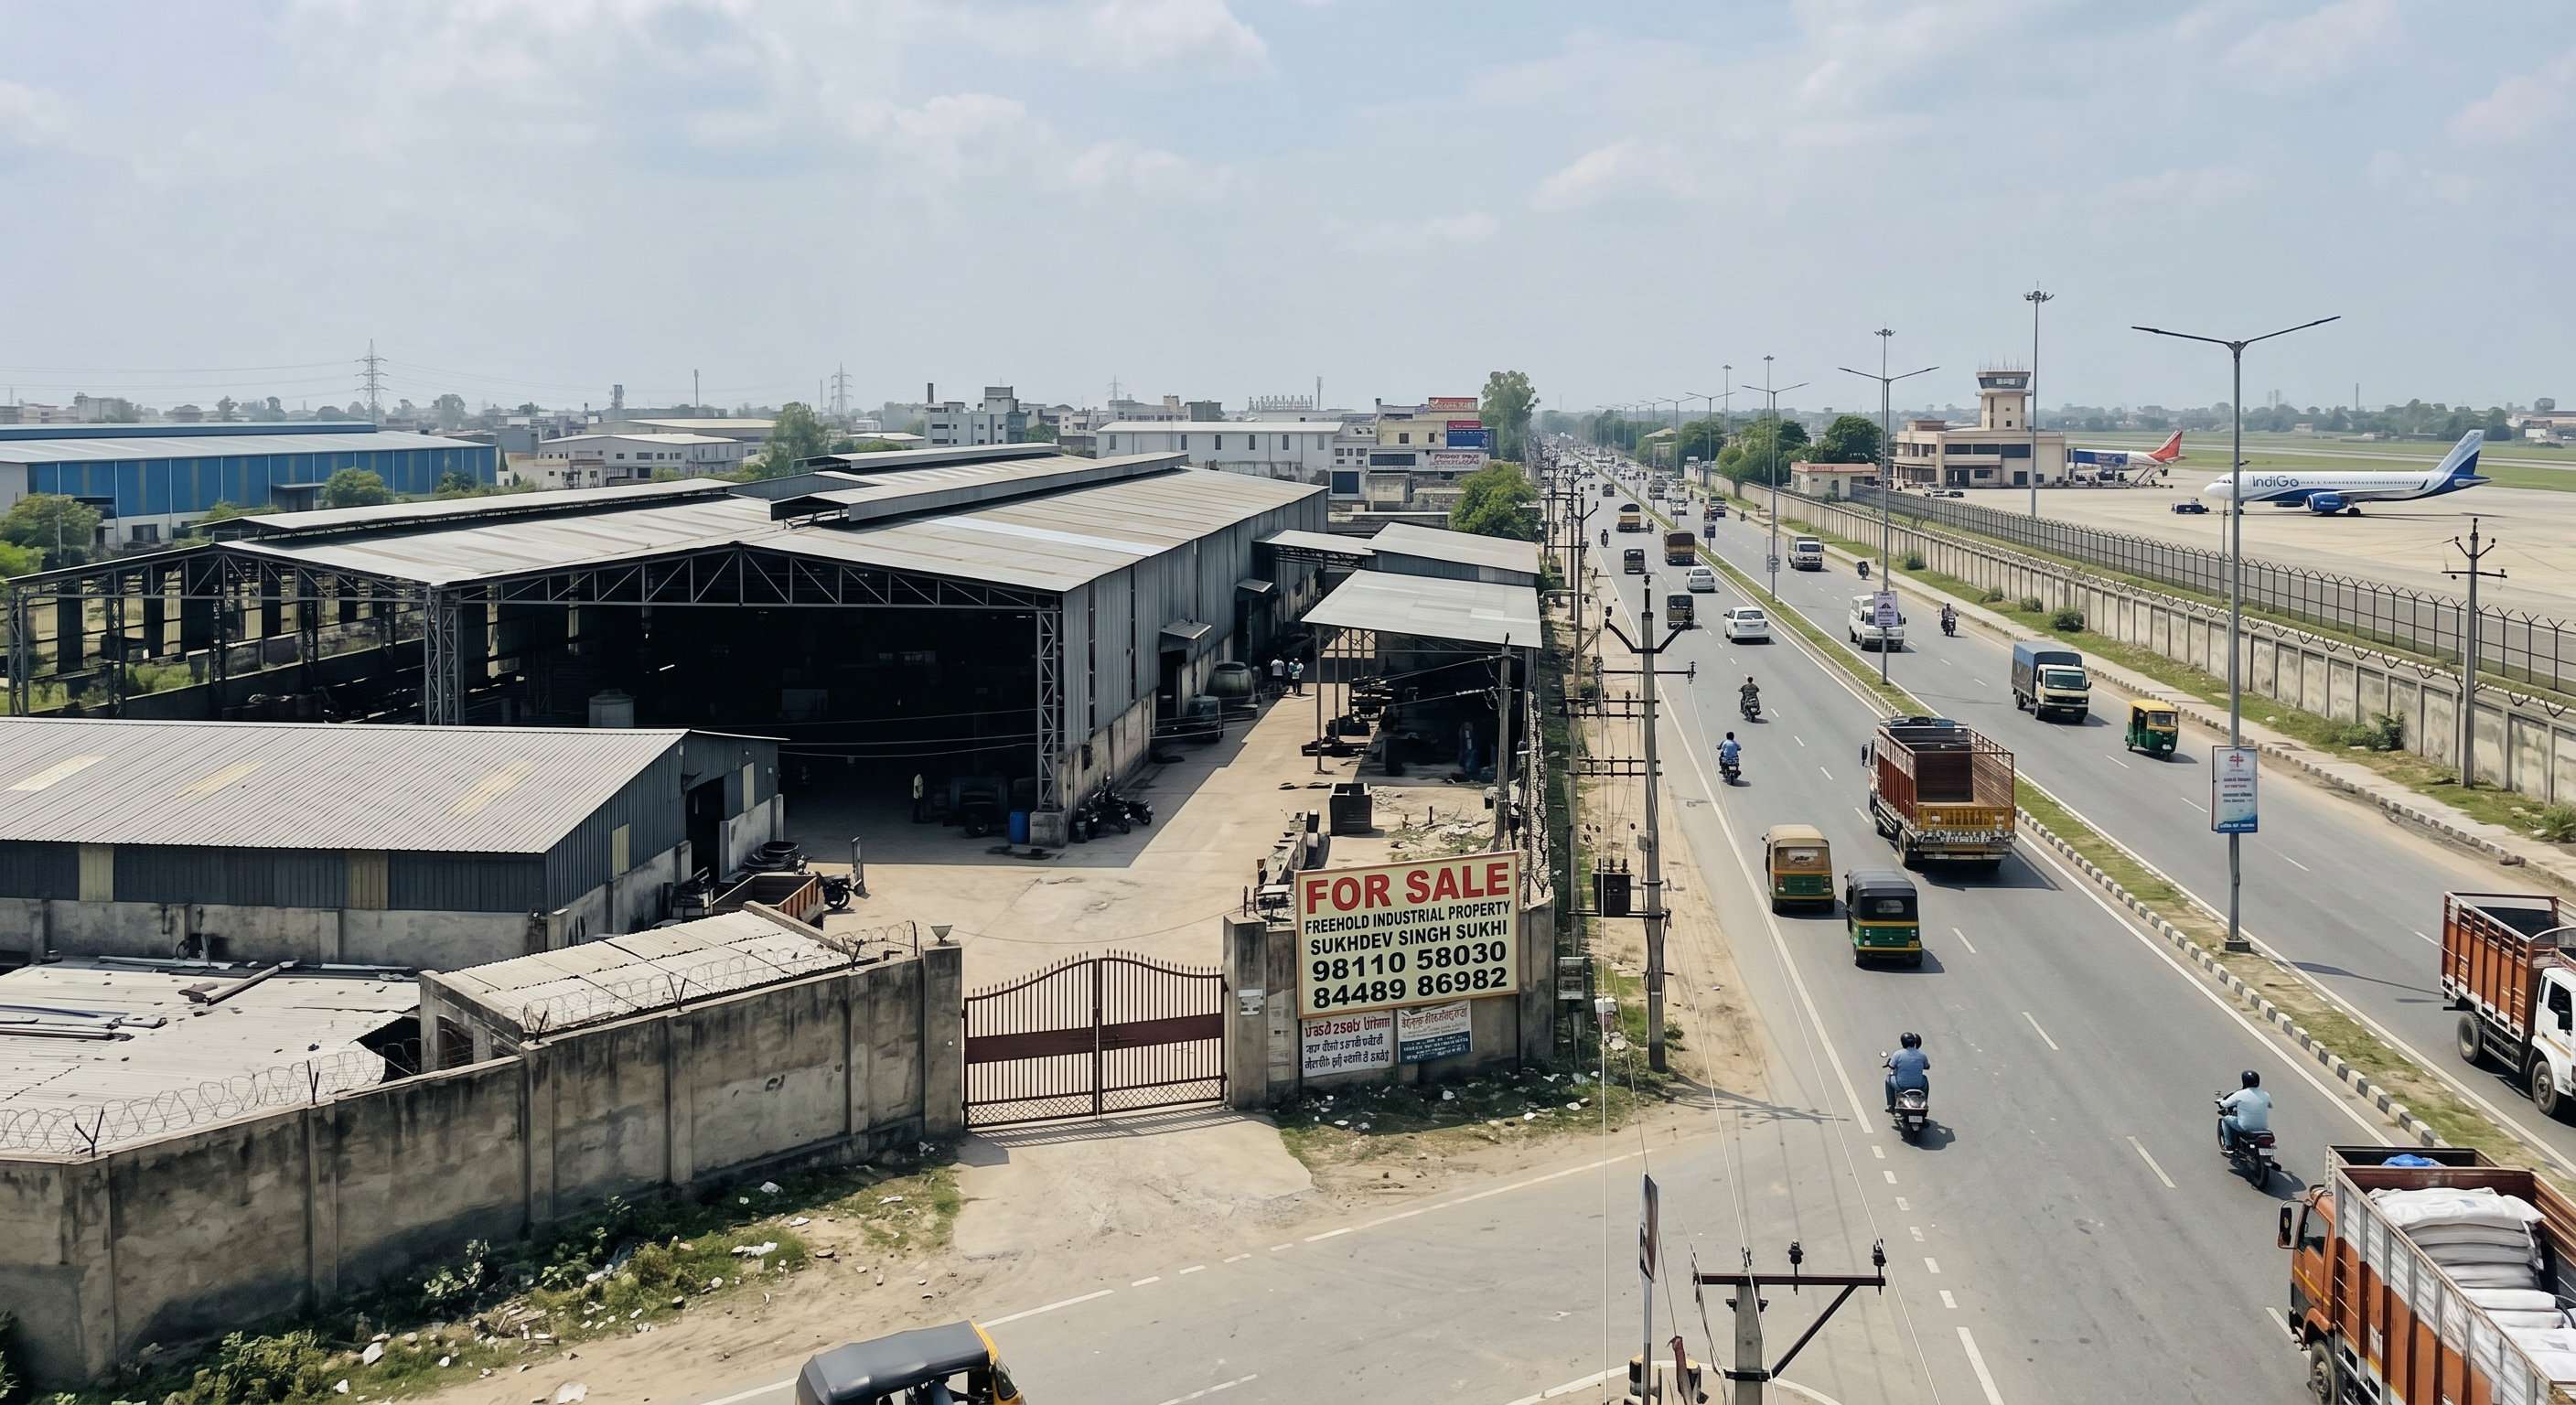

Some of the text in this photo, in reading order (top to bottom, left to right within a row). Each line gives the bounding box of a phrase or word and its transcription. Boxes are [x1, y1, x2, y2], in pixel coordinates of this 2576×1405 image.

[2252, 476, 2299, 488] IndiGo
[1305, 862, 1510, 915] FOR SALE
[1304, 900, 1511, 935] FREEHOLD INDUSTRIAL PROPERTY
[1310, 919, 1508, 956] SUKHDEV SINGH SUKHI
[1312, 940, 1507, 982] 98110 58030
[1313, 966, 1508, 1009] 84489 86982
